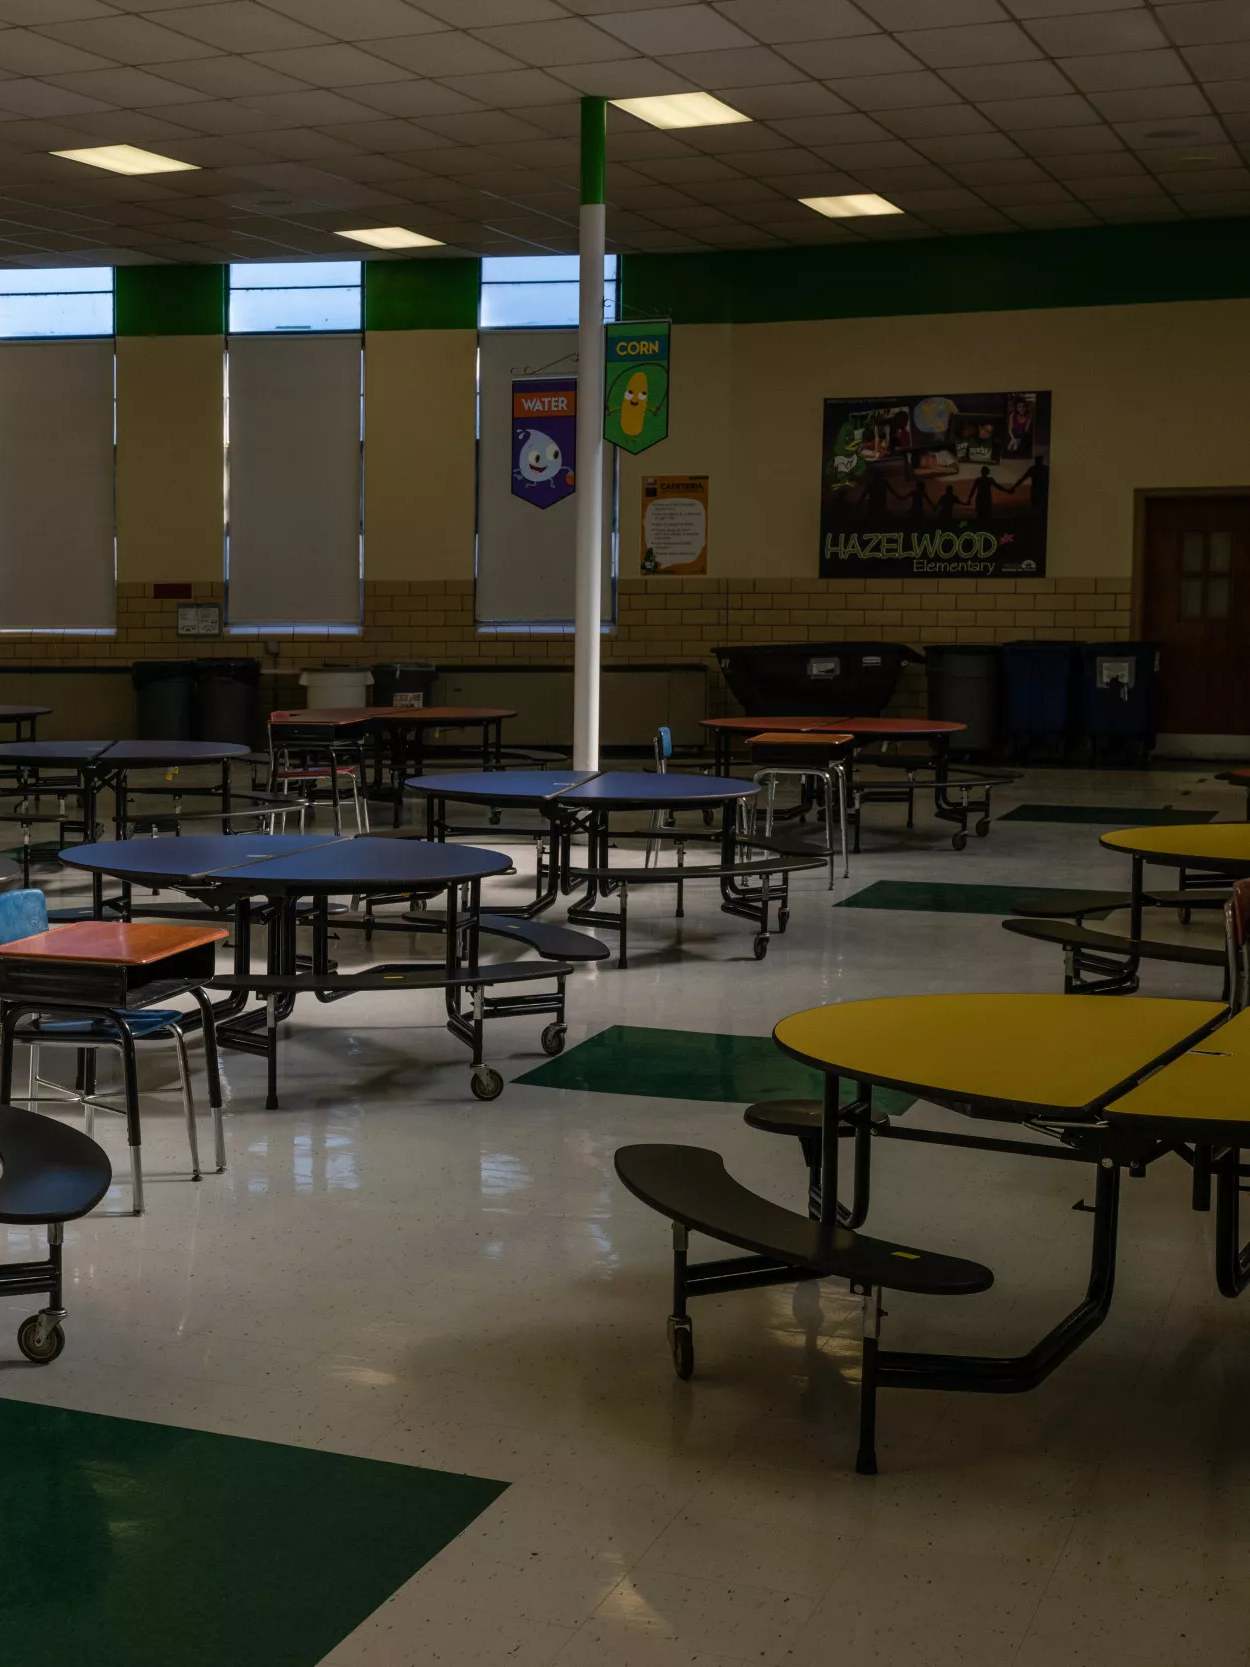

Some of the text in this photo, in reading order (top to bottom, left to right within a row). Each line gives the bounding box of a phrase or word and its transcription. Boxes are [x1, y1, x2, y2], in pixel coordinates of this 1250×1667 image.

[616, 340, 659, 356] CORN
[522, 396, 568, 412] WATER
[660, 482, 704, 490] CAFETERIA
[824, 529, 997, 560] HAZELWOOD
[912, 559, 996, 576] Elementary
